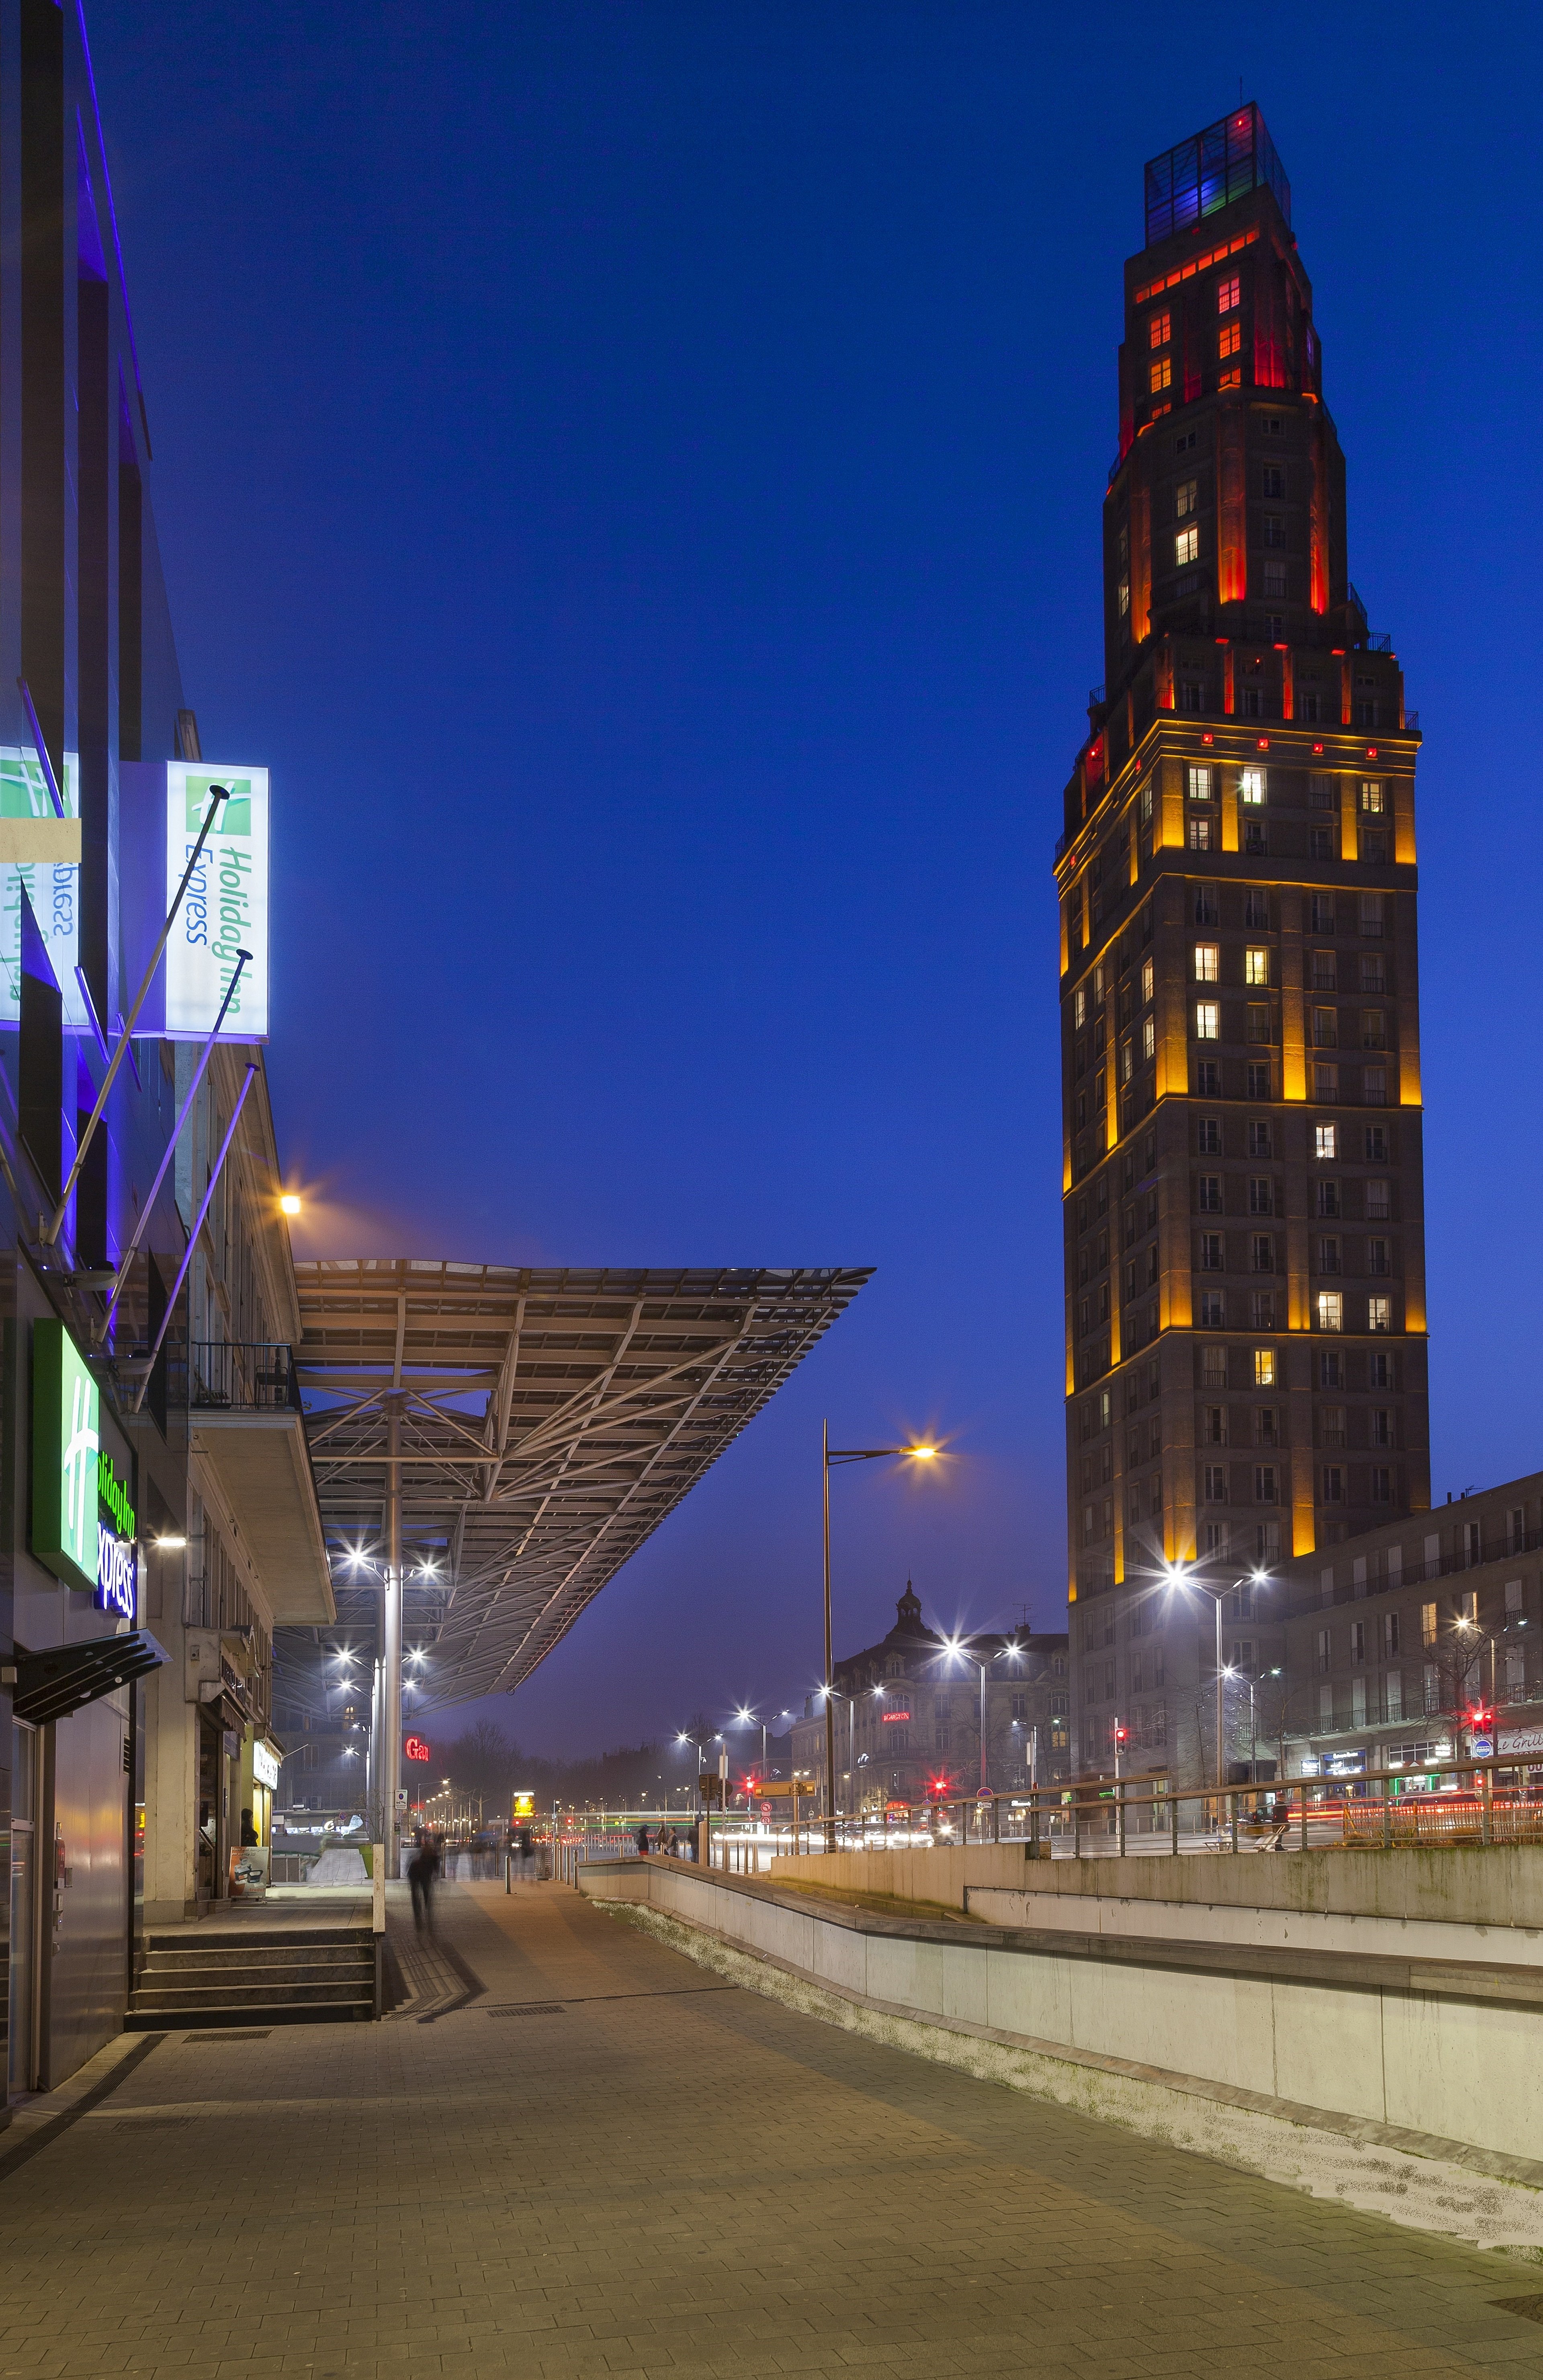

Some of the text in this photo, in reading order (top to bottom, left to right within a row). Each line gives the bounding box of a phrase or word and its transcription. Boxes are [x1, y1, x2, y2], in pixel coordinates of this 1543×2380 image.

[178, 844, 213, 946] Express
[211, 847, 252, 1014] Holiday Inn
[97, 1522, 133, 1619] xpress
